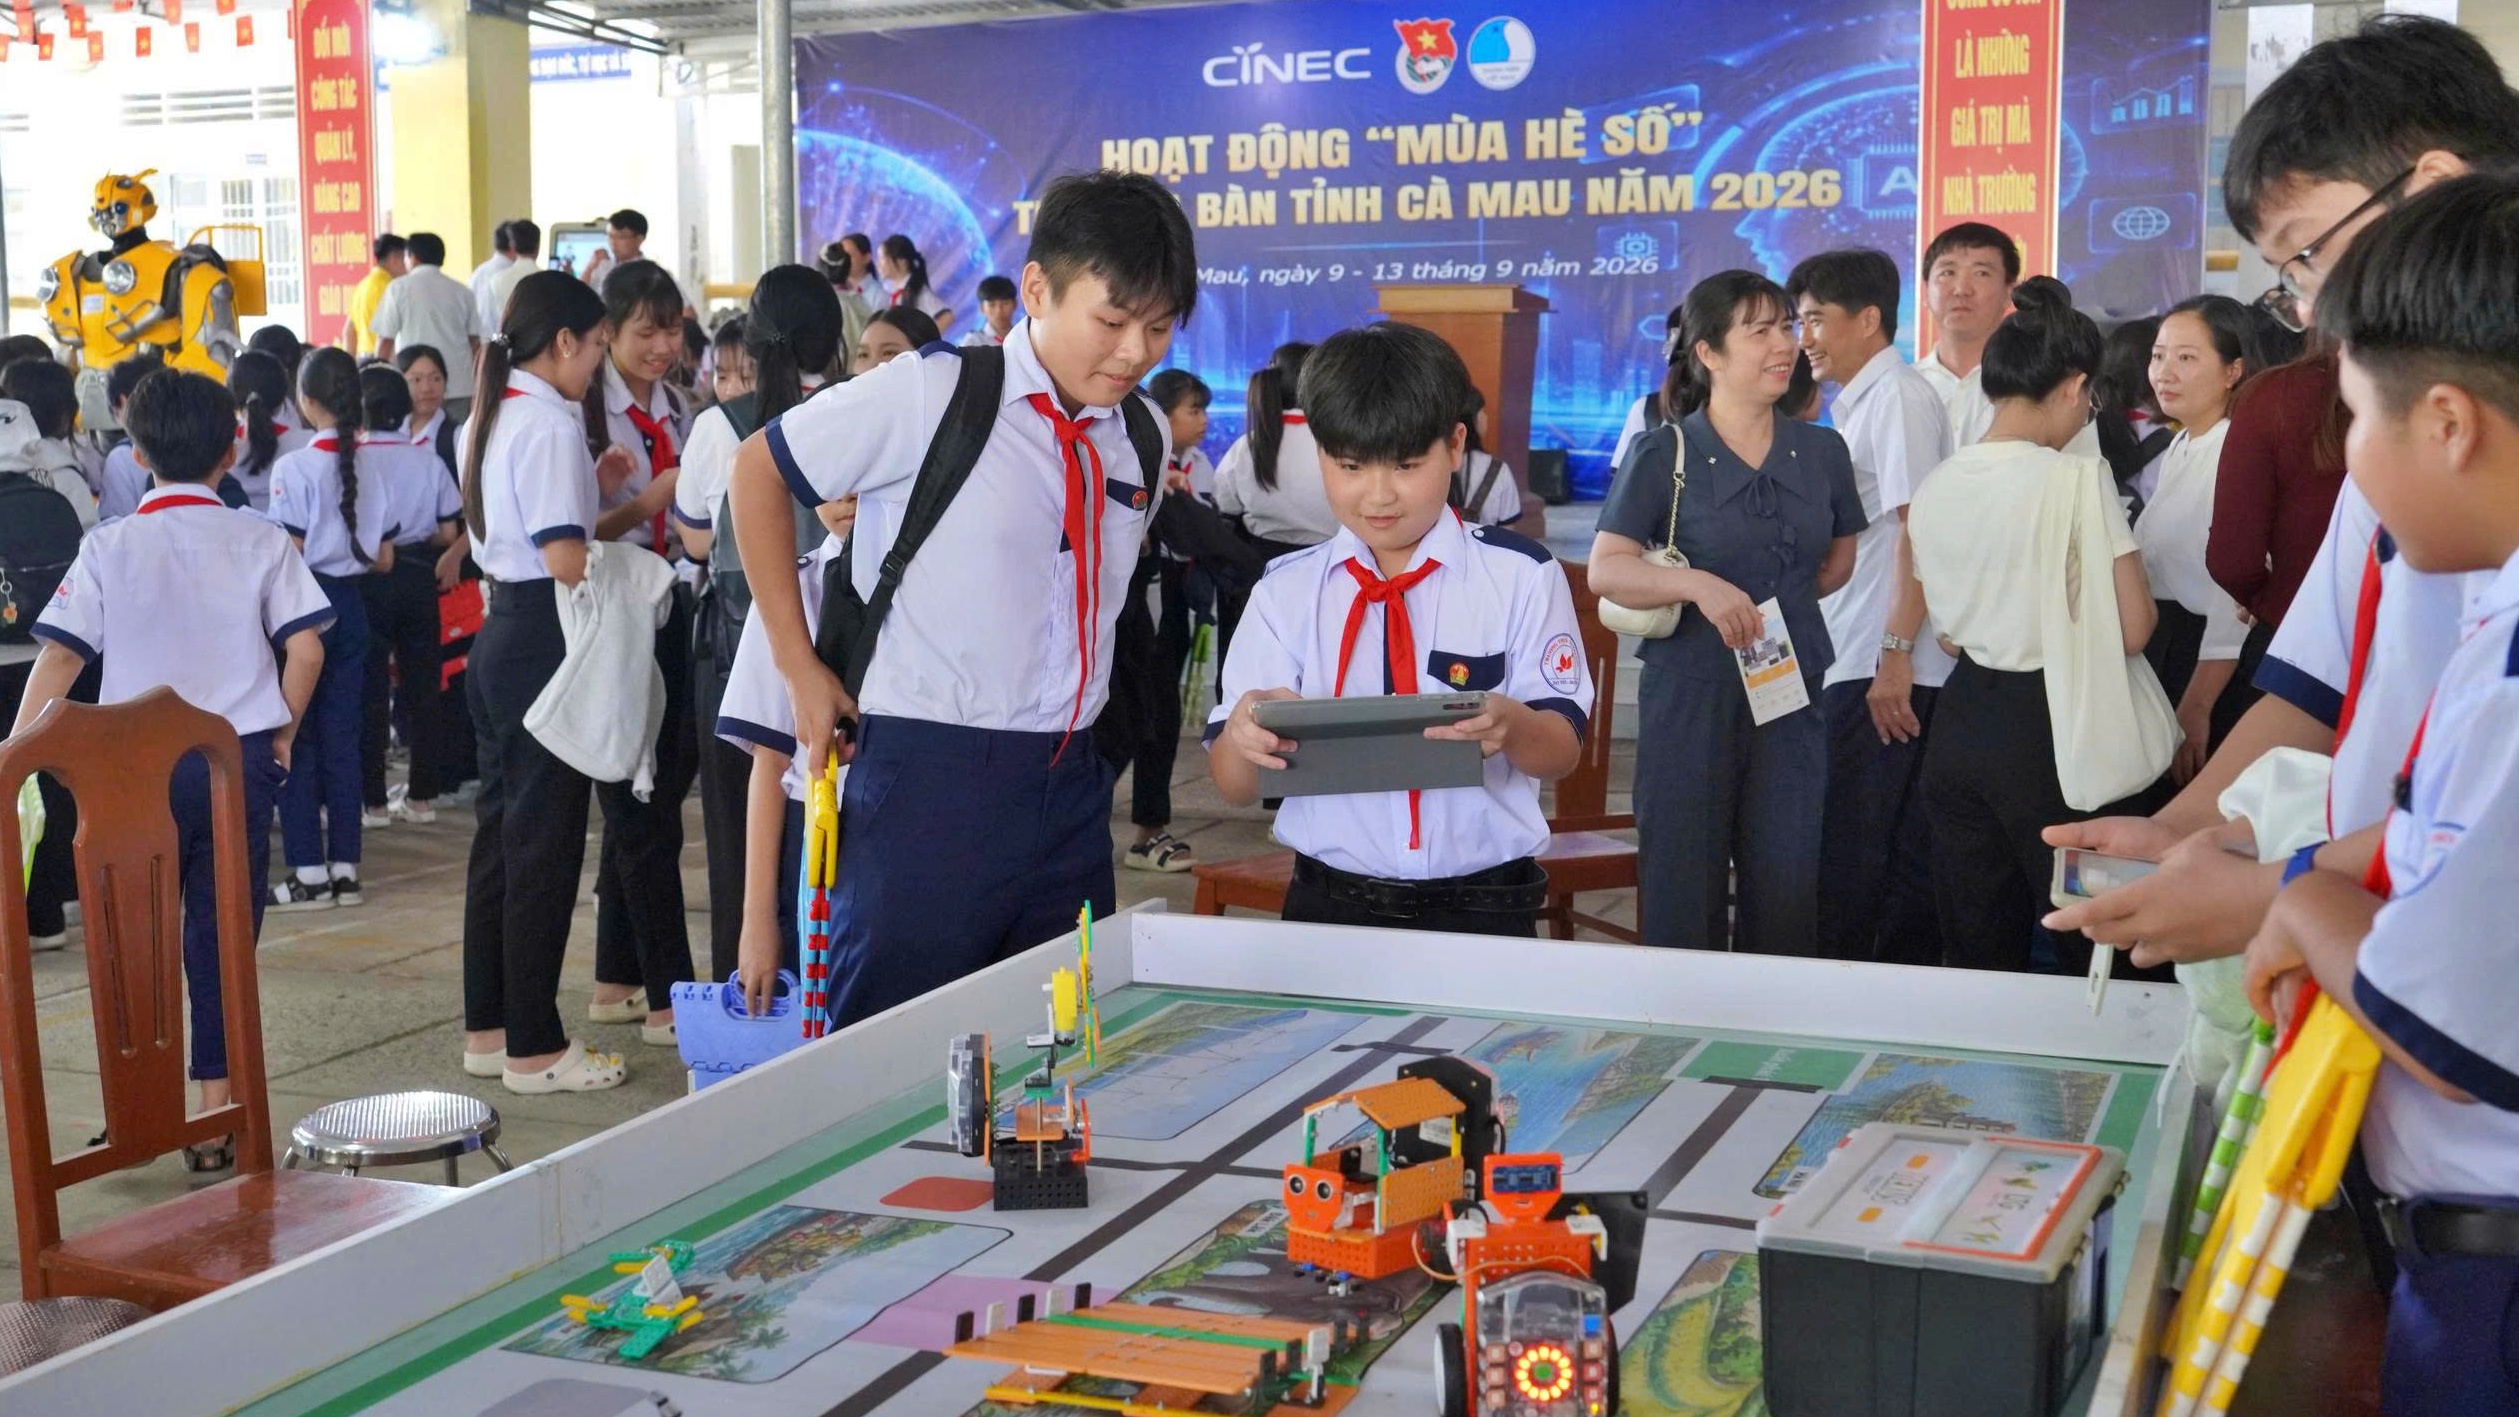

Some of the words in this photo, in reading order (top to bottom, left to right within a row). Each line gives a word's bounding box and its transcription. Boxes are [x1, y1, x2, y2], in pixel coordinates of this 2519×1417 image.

[1203, 43, 1371, 87] CINEC
[1955, 30, 1974, 78] LÀ
[1977, 28, 2030, 77] NHỮNG
[1101, 135, 1213, 183] HOẠT
[1227, 123, 1350, 179] ĐỘNG
[1366, 113, 1508, 164] “MÙA
[1526, 107, 1586, 159] HÈ
[1604, 103, 1703, 155] SỐ”
[1951, 99, 1976, 147] GIÁ
[1980, 105, 2003, 154] TRỊ
[2006, 96, 2032, 144] MÀ
[1197, 183, 1277, 228] BÀN
[1290, 176, 1382, 224] TỈNH
[1397, 175, 1453, 219] CÀ
[1468, 179, 1570, 219] MAU
[1586, 167, 1693, 215] NĂM
[1711, 169, 1842, 211] 2026
[1943, 167, 1974, 215] NHÀ
[1977, 164, 2037, 214] TRƯỜNG
[1197, 266, 1249, 286] Mau,
[1259, 264, 1320, 287] ngày
[1328, 264, 1345, 282] 9
[1373, 263, 1404, 281] 13
[1412, 259, 1486, 282] tháng
[1495, 260, 1514, 277] 9
[1522, 256, 1580, 277] năm
[1590, 256, 1659, 276] 2026
